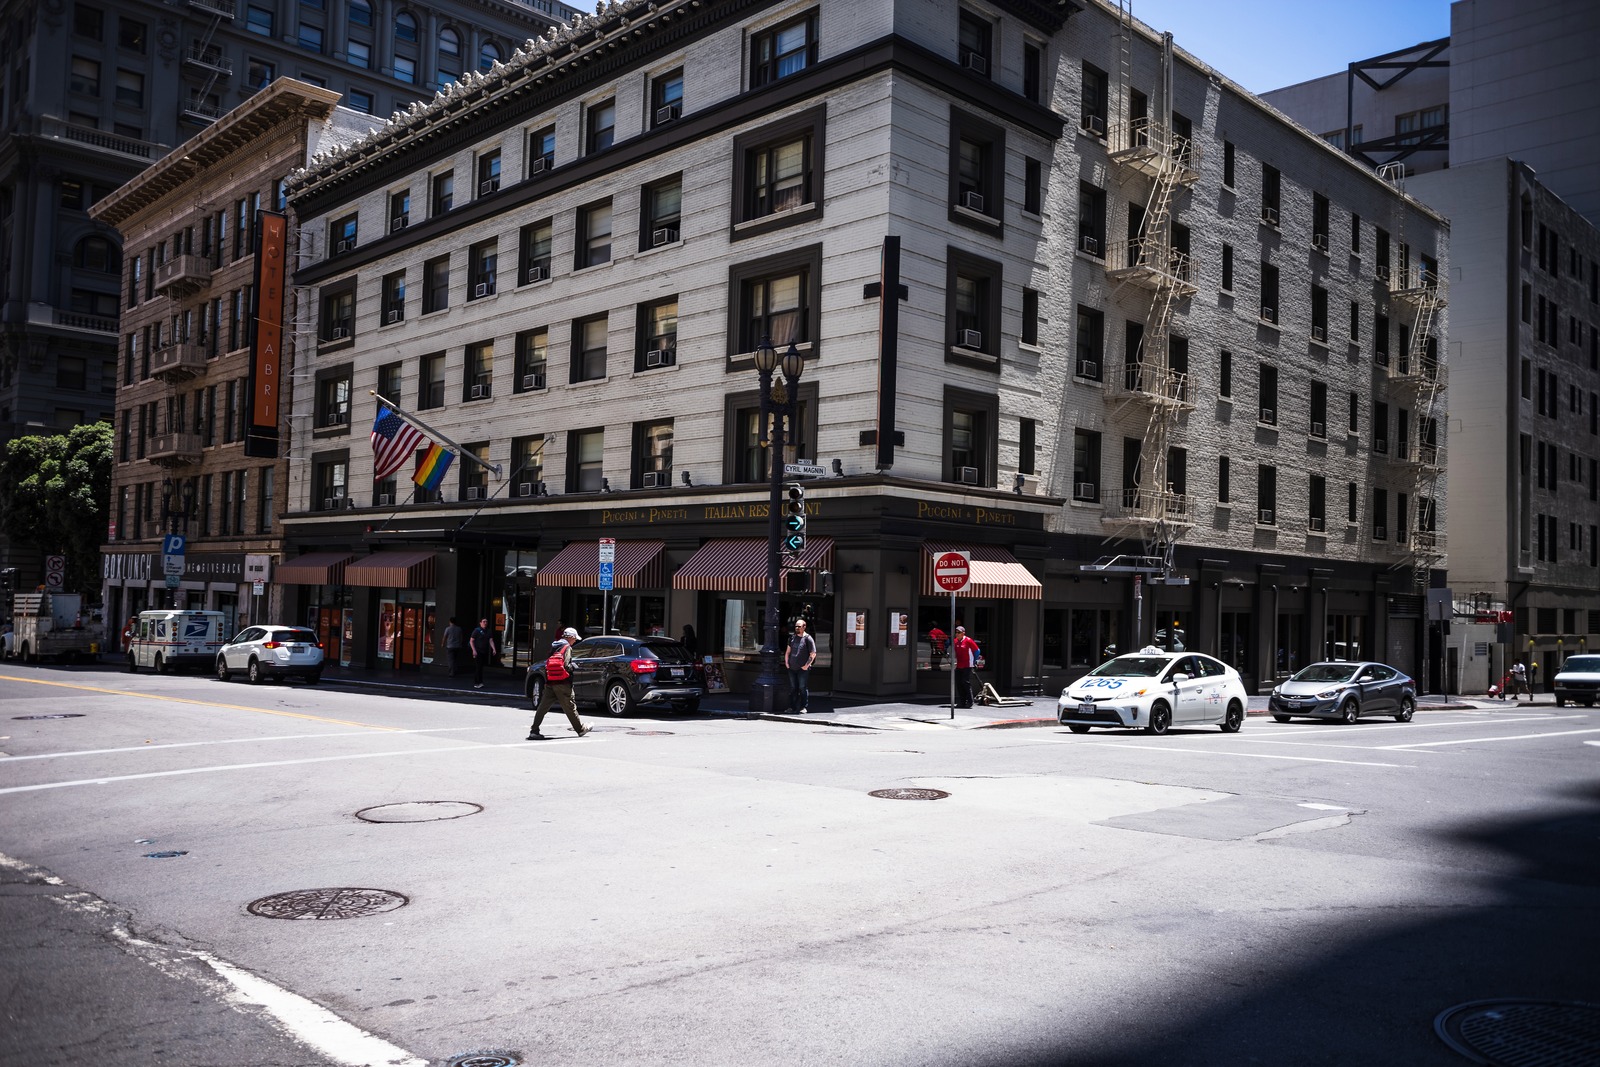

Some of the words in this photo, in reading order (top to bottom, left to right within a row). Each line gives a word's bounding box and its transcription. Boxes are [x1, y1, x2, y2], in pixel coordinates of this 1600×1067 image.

[264, 343, 274, 417] ABRI
[785, 465, 802, 473] CYRIL
[803, 466, 824, 475] MAGNIN
[704, 505, 745, 519] ITALIAN
[749, 502, 822, 518] RESUNT
[103, 554, 152, 580] BOXLUNCH
[201, 562, 219, 573] GIVE
[221, 563, 241, 574] BACK
[951, 559, 965, 567] NOT
[941, 576, 963, 584] ENTER
[1080, 678, 1128, 690] 1265
